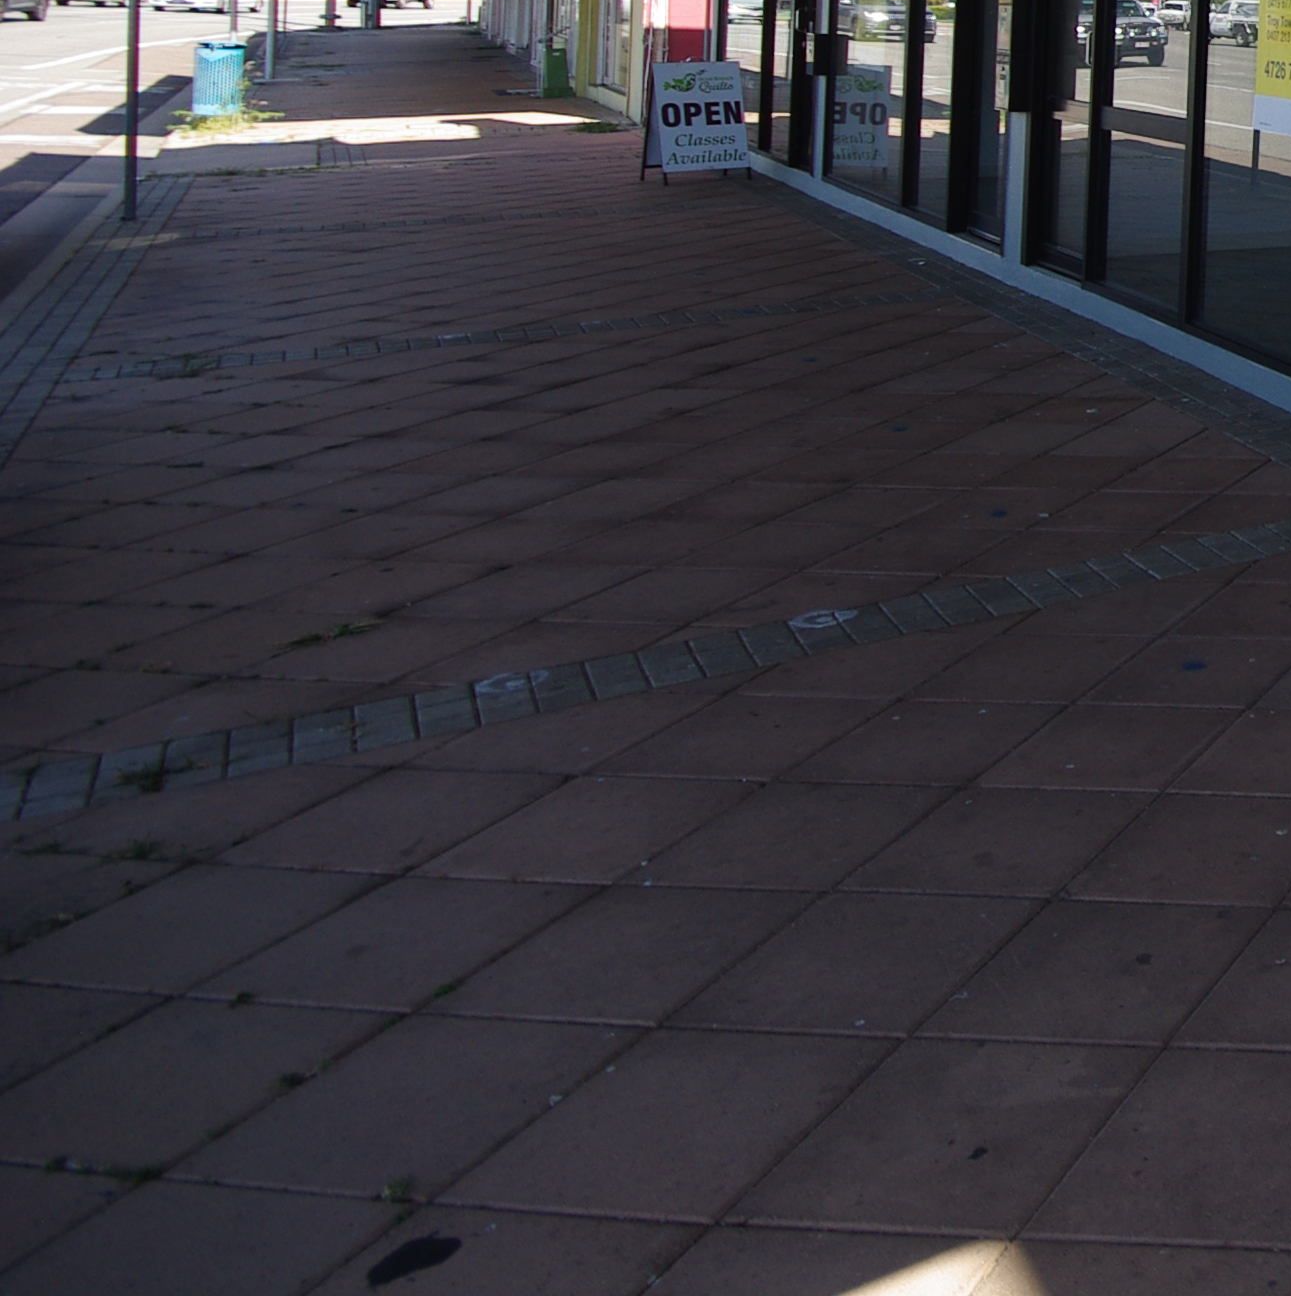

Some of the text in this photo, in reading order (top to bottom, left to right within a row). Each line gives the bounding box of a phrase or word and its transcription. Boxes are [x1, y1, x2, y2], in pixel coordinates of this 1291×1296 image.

[1264, 60, 1286, 80] 4726
[661, 100, 743, 127] OPEN
[674, 133, 736, 147] Classes
[666, 148, 748, 165] Available
